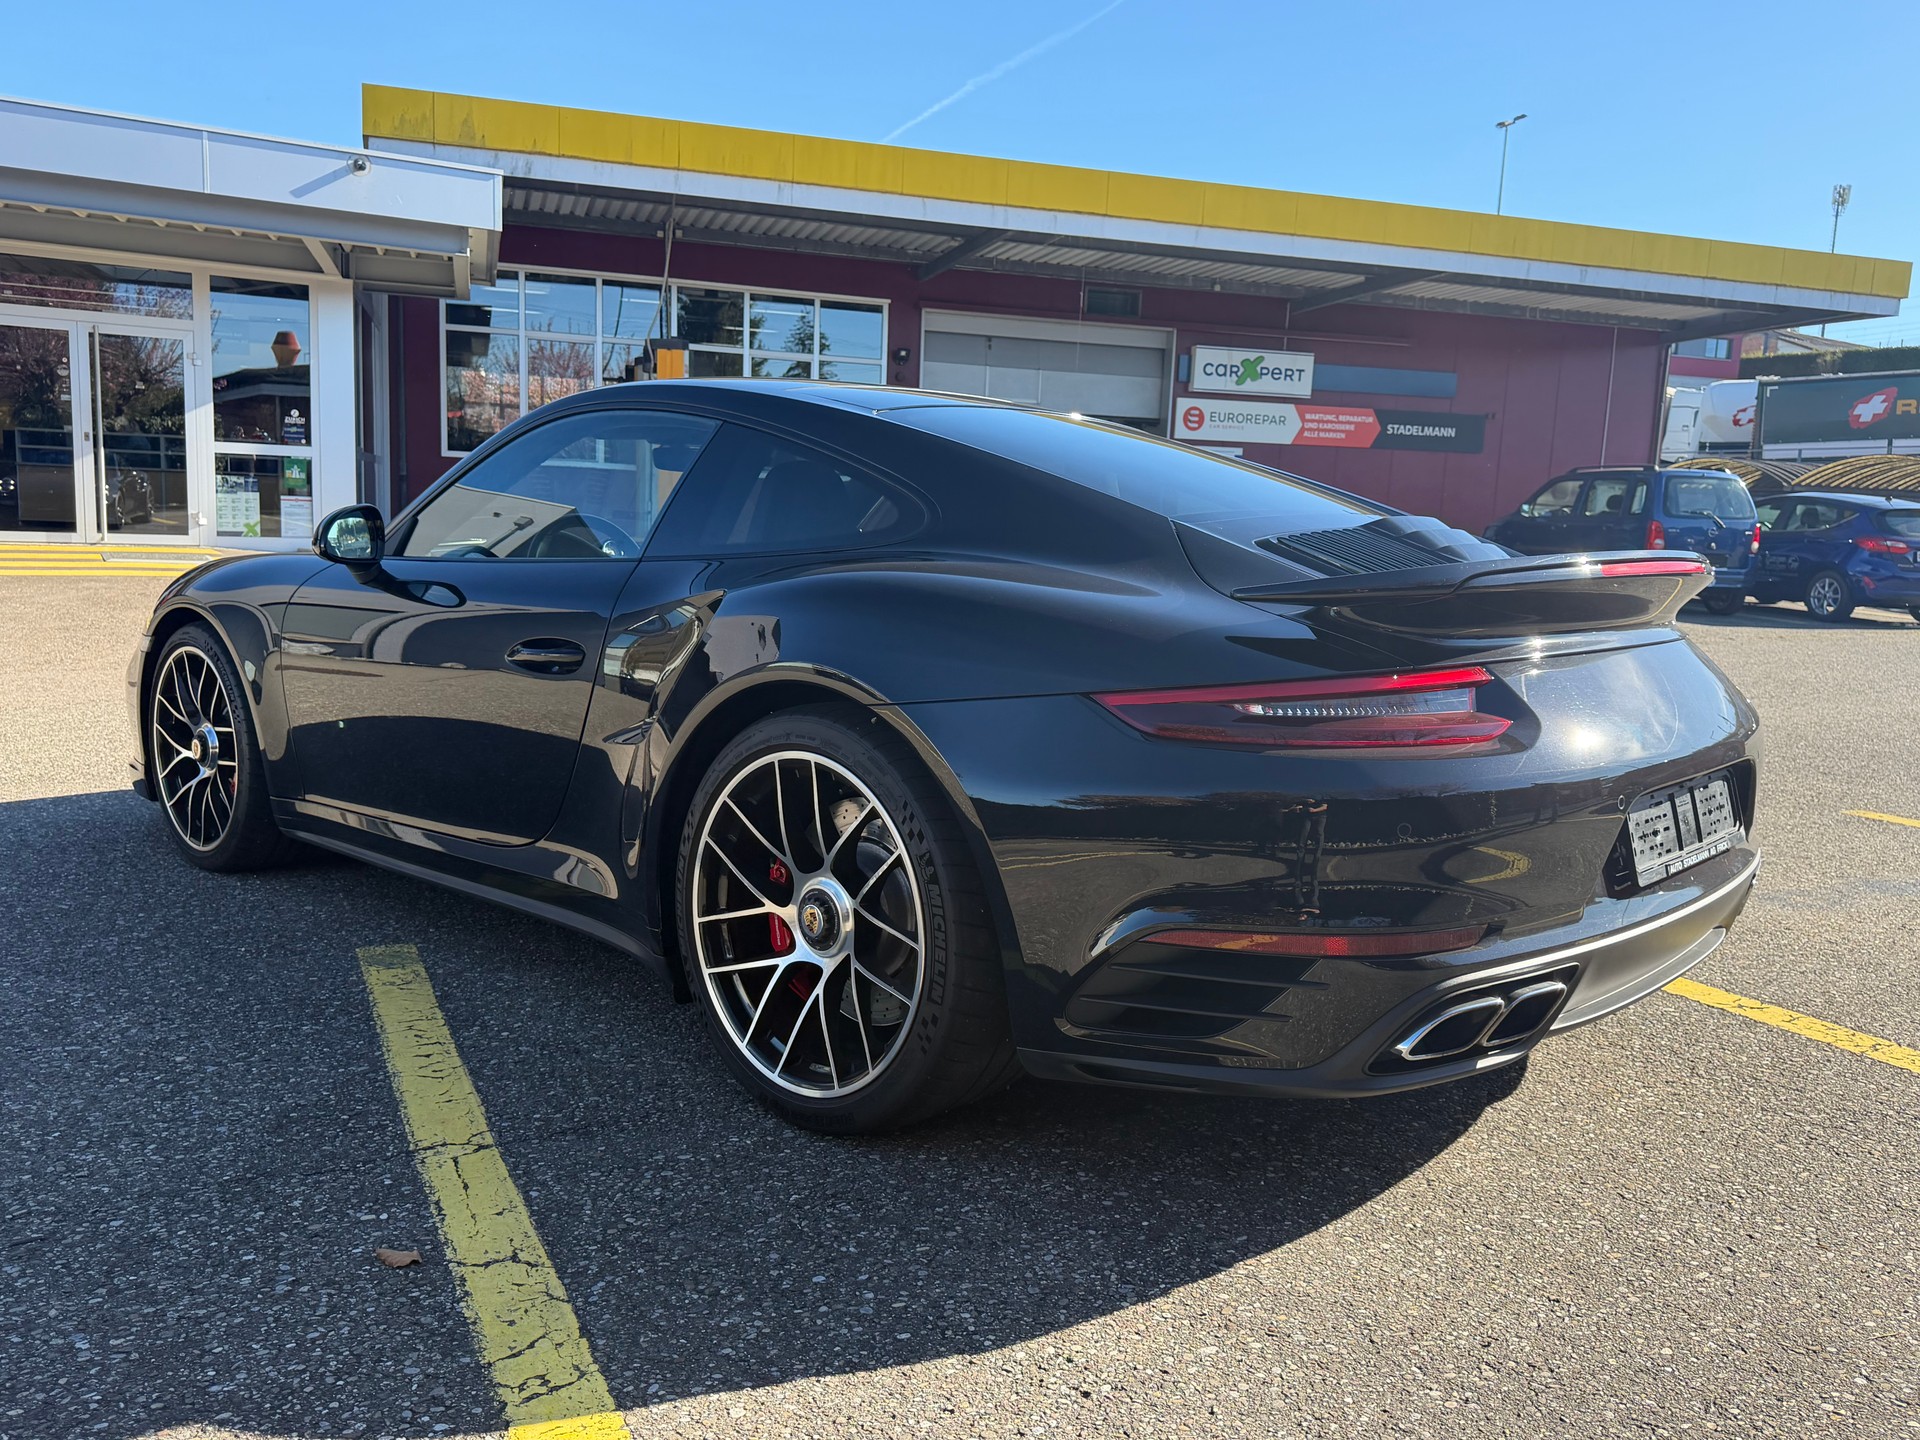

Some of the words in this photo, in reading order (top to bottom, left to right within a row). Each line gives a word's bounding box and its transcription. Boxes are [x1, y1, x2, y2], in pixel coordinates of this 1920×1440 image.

[1896, 399, 1920, 415] R
[1209, 411, 1287, 426] EUROREPAR
[1338, 414, 1373, 423] REPARATUR
[1303, 430, 1319, 438] ALLE
[1319, 431, 1345, 439] MARKEN
[1386, 424, 1456, 437] STADELMANN
[217, 660, 236, 701] MICHELIN
[928, 883, 947, 1005] MICHELIN
